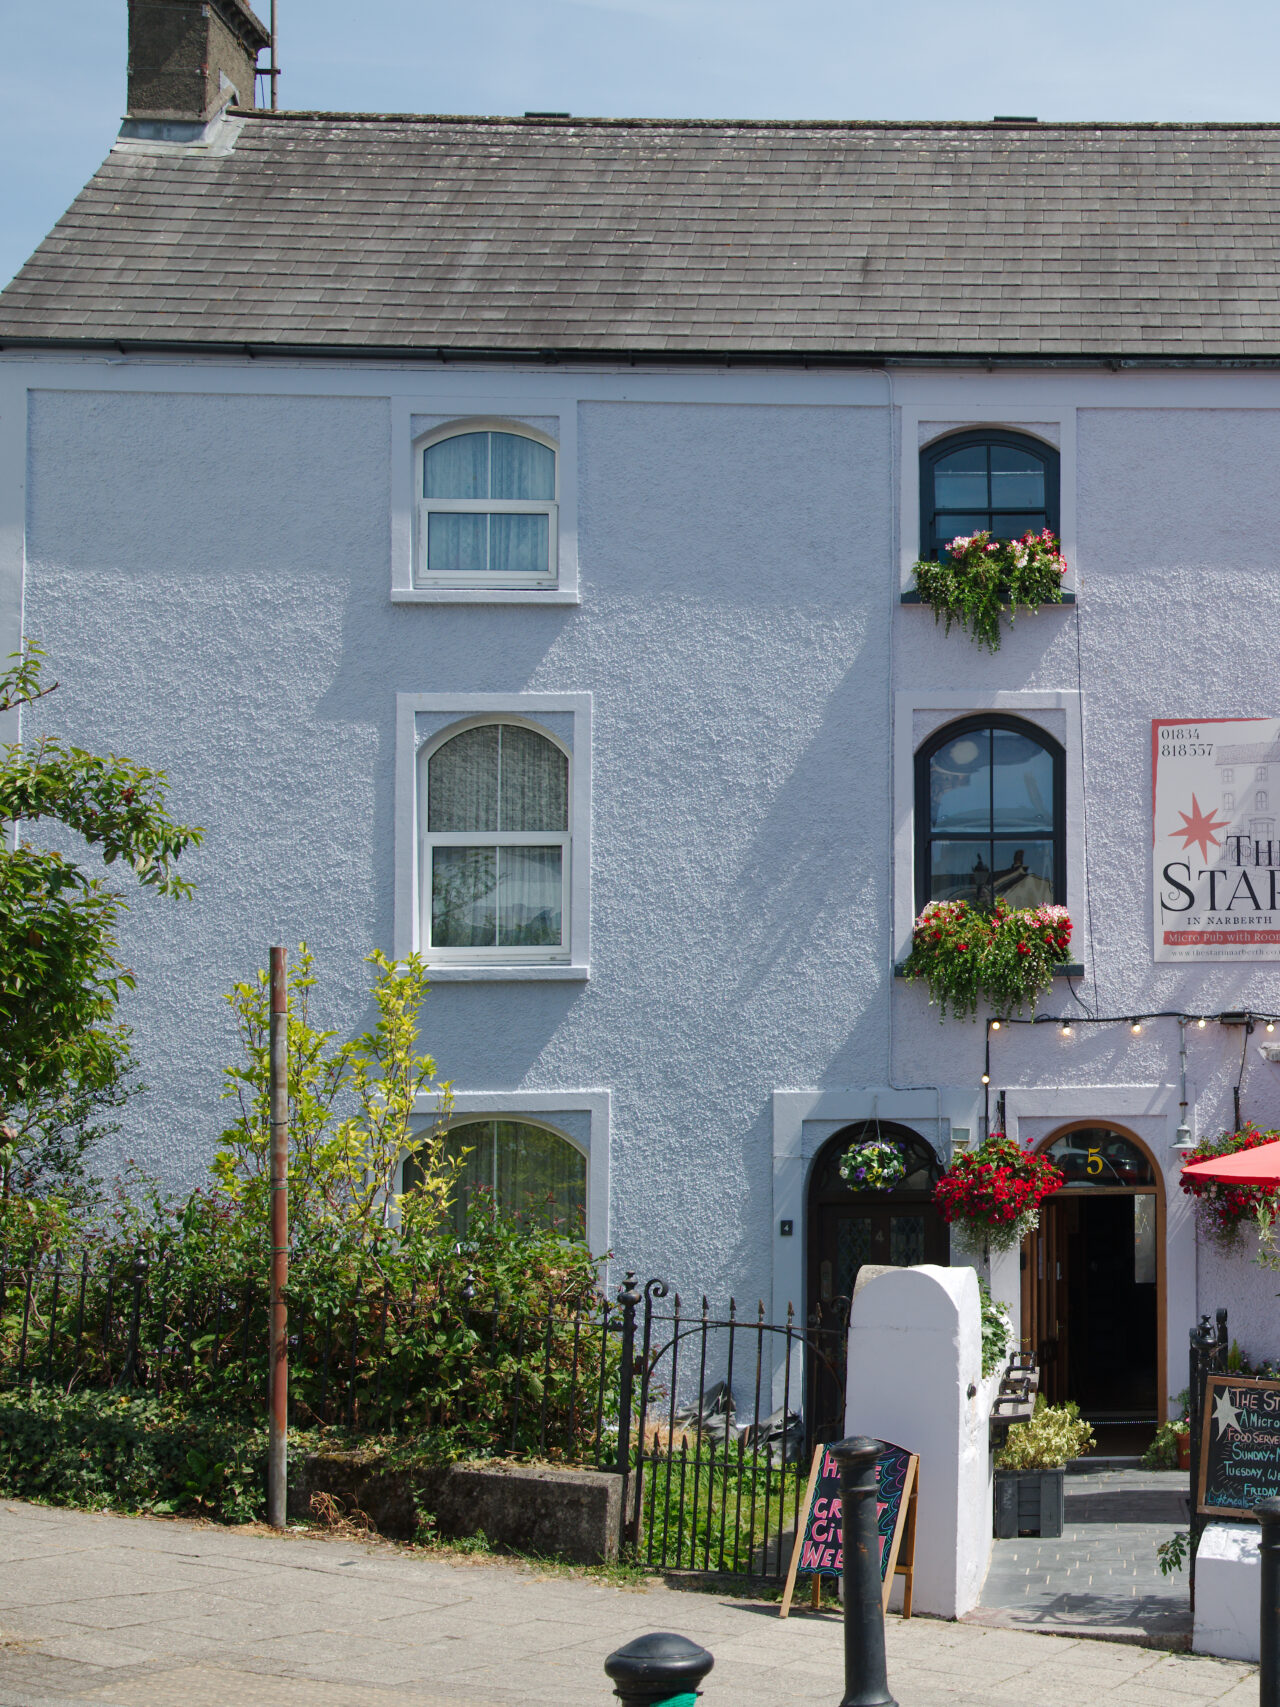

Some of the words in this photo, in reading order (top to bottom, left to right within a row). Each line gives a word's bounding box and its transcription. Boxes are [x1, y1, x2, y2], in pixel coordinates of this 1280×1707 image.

[1161, 728, 1200, 740] 01834
[1161, 743, 1214, 757] 818557
[1187, 916, 1201, 925] IN
[1207, 916, 1273, 925] NARBERTH
[1168, 933, 1200, 943] Micro
[1203, 933, 1224, 943] Pub
[1227, 932, 1250, 942] with
[1086, 1147, 1104, 1175] 5
[783, 1224, 790, 1232] 4
[1231, 1388, 1259, 1409] THE
[1240, 1407, 1249, 1428] A
[1249, 1412, 1280, 1429] Micro
[1227, 1427, 1252, 1442] FOOD
[1232, 1441, 1270, 1461] SUNDAY
[1243, 1482, 1279, 1497] FRIDAY
